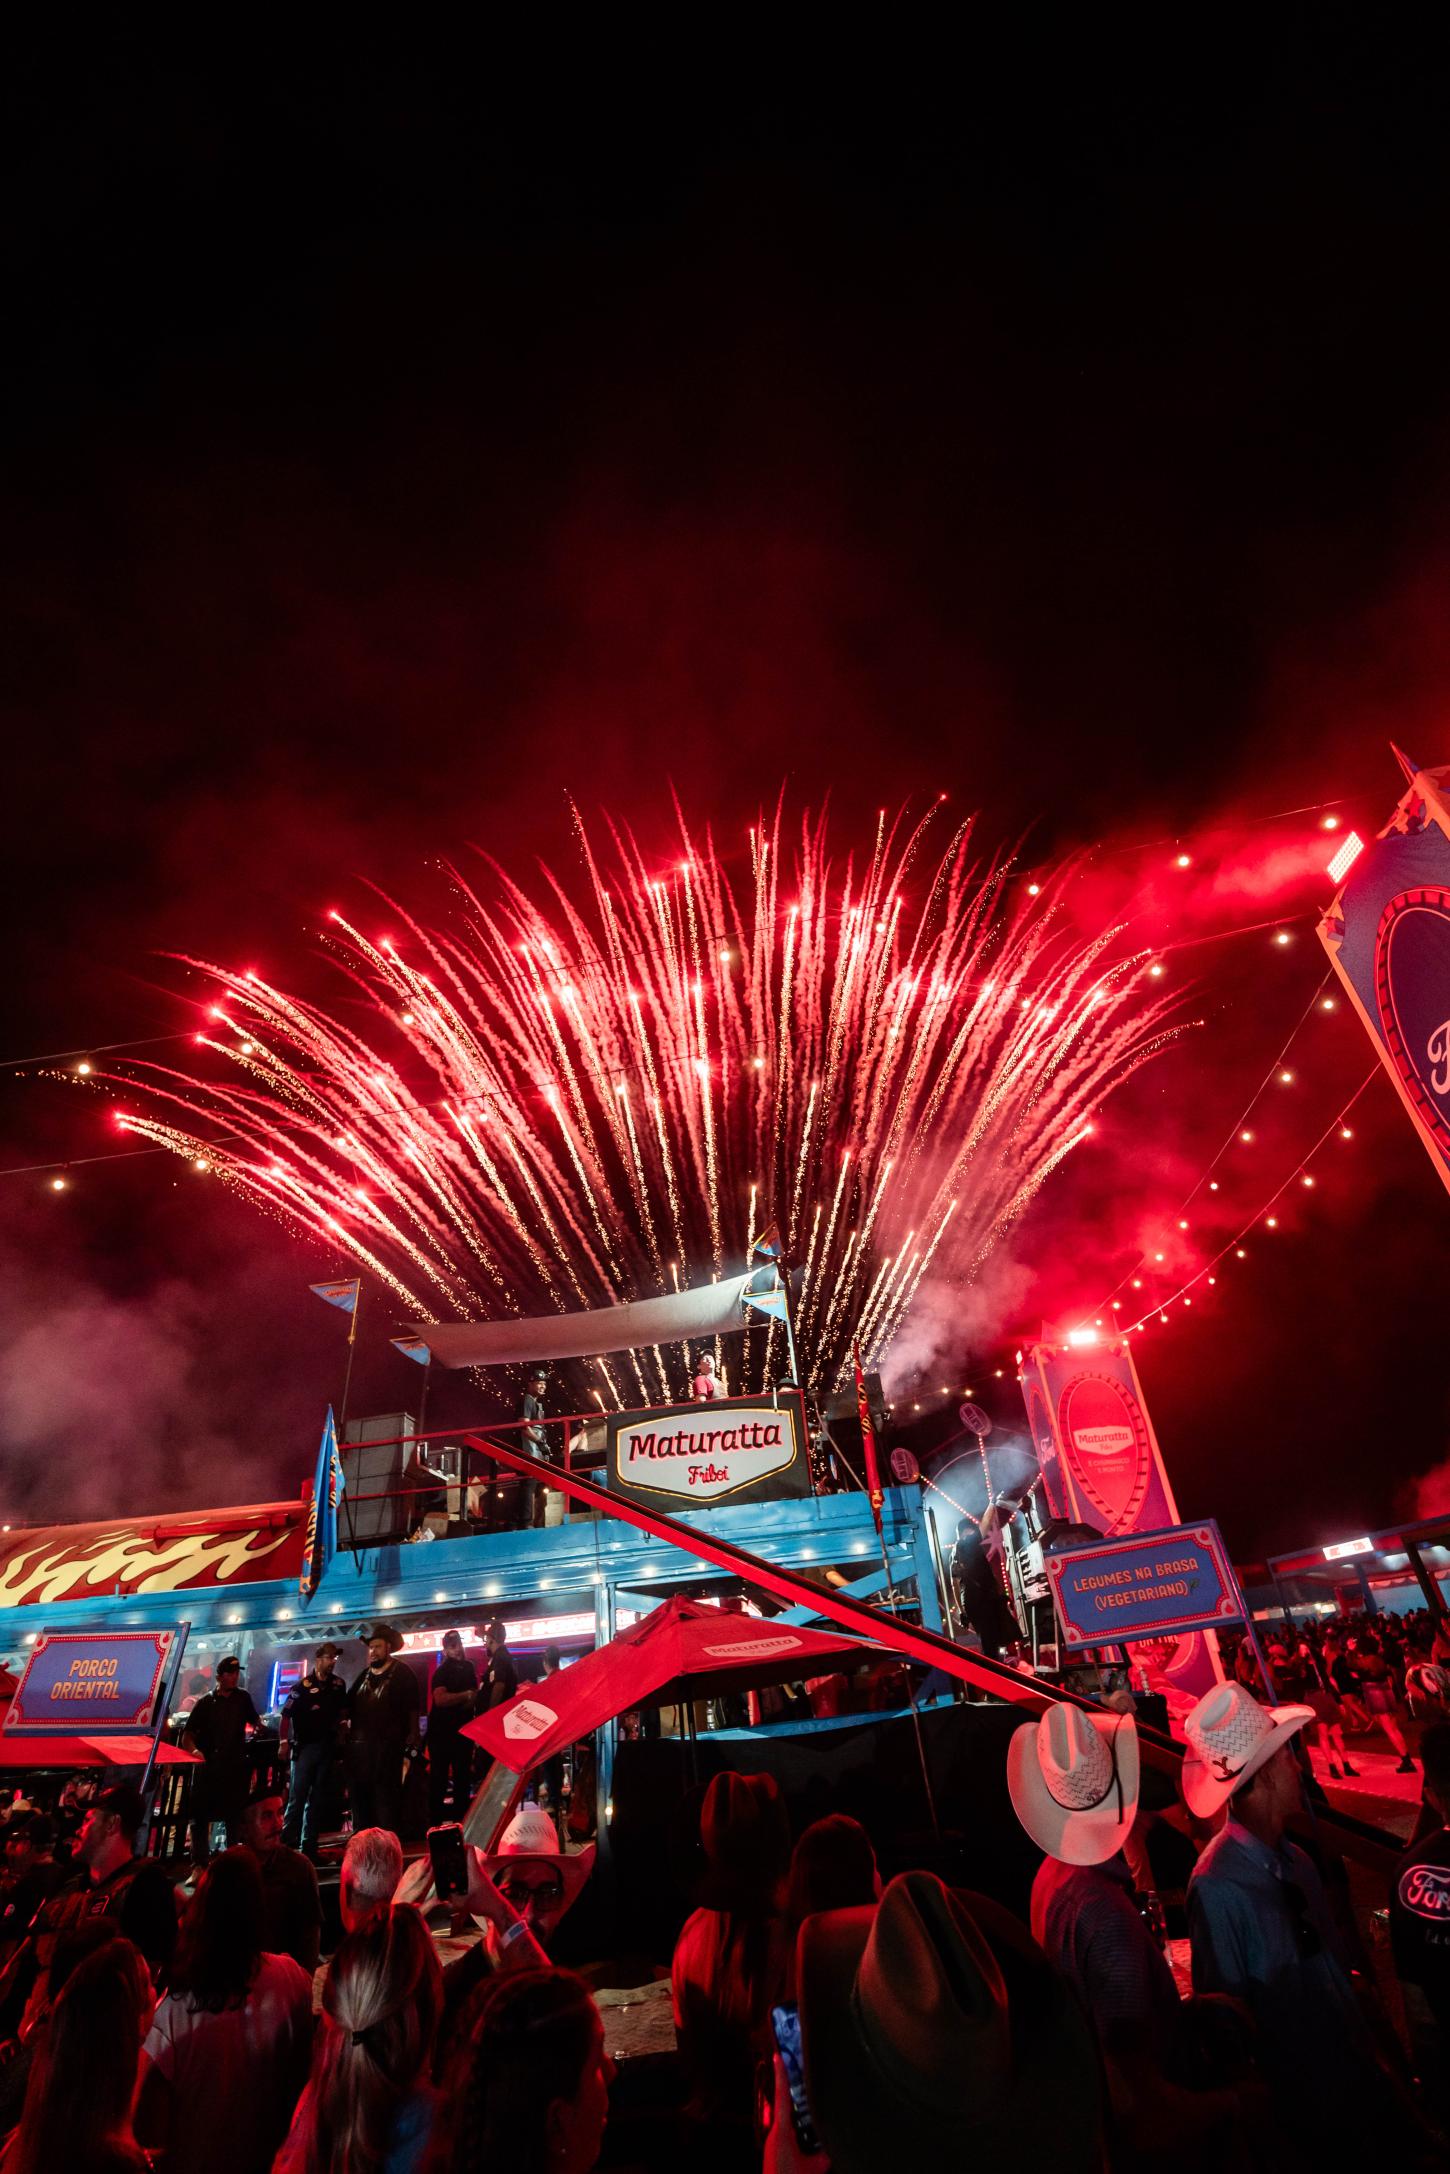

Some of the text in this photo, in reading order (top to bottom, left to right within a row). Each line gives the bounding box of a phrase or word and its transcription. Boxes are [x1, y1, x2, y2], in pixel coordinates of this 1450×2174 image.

[628, 1422, 782, 1462] Maturatta
[1078, 1432, 1128, 1444] Maturatta
[688, 1463, 730, 1487] Friboi
[1074, 1557, 1199, 1593] LEGUMES NA BRASA
[1095, 1580, 1189, 1612] (VEGETARIANO)
[712, 1639, 794, 1654] Maturatta
[69, 1658, 118, 1677] PORCO
[51, 1680, 119, 1701] ORIENTAL
[1407, 1870, 1450, 1908] For
